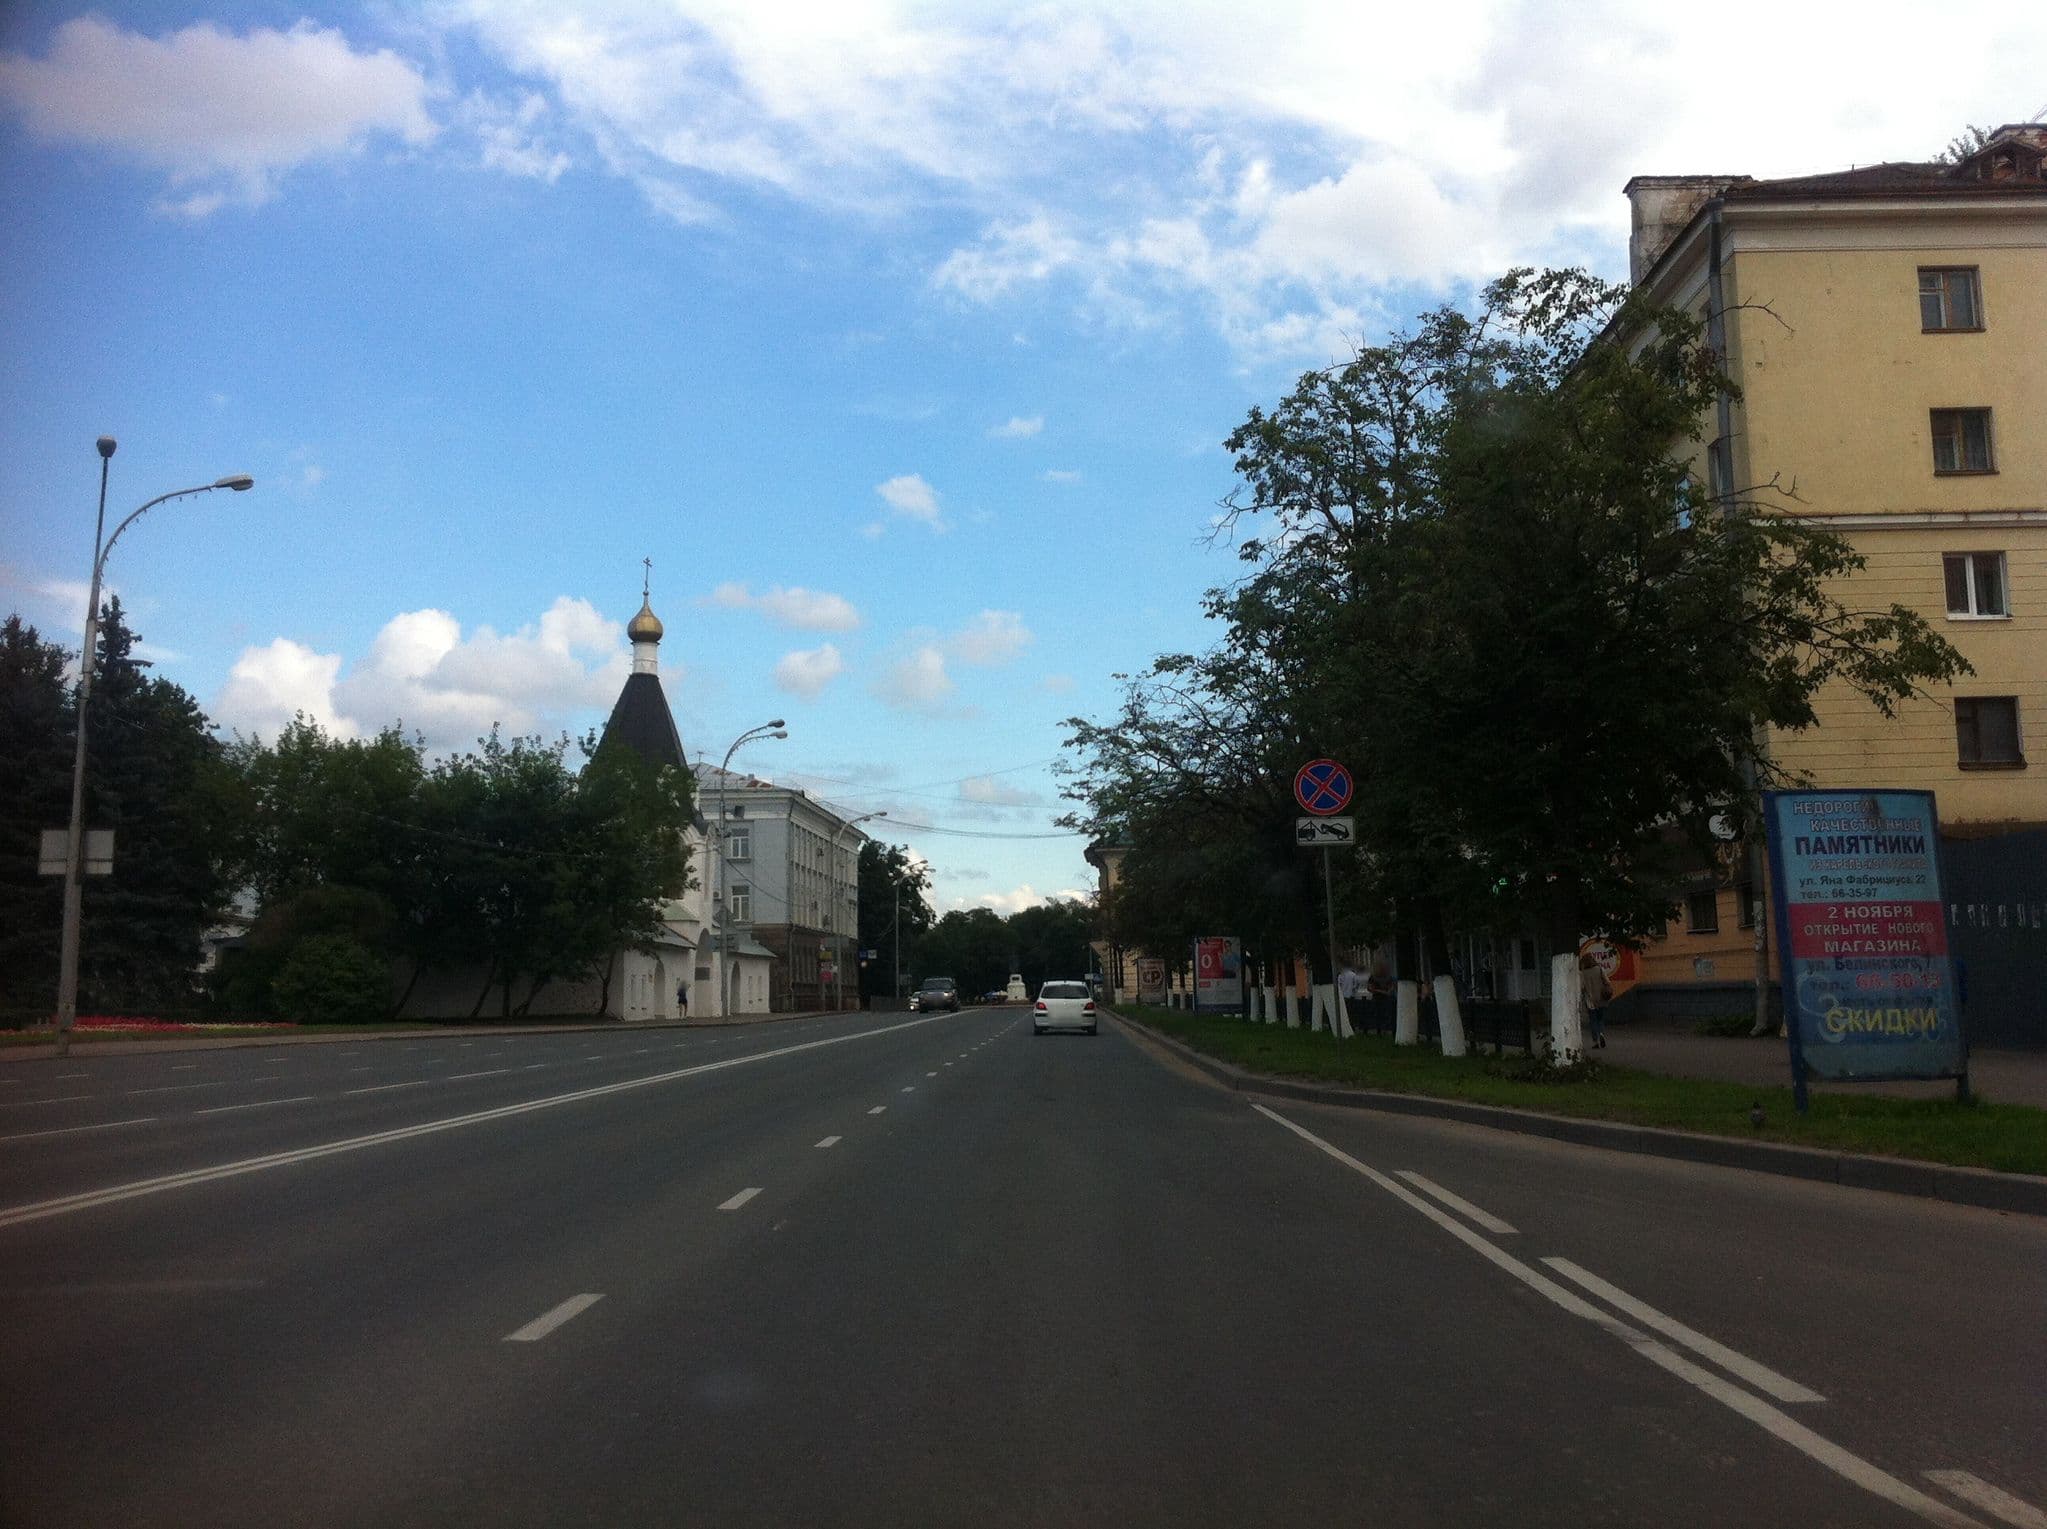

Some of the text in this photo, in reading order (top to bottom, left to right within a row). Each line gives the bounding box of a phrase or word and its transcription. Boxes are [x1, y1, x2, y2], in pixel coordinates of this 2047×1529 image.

[1792, 799, 1877, 816] НЕДОРОГИ
[1795, 834, 1926, 856] ПАМЯТНИКИ
[1799, 877, 1817, 888] ул.
[1820, 875, 1843, 886] Яна
[1831, 887, 1878, 899] 66-35-97
[1827, 904, 1914, 919] 2 НОЯБРЯ
[1803, 921, 1935, 937] ОТКРЫТИЕ НОВОГО
[1824, 939, 1922, 954] МАГАЗИНА
[1825, 1007, 1938, 1034] СКИДКИ
